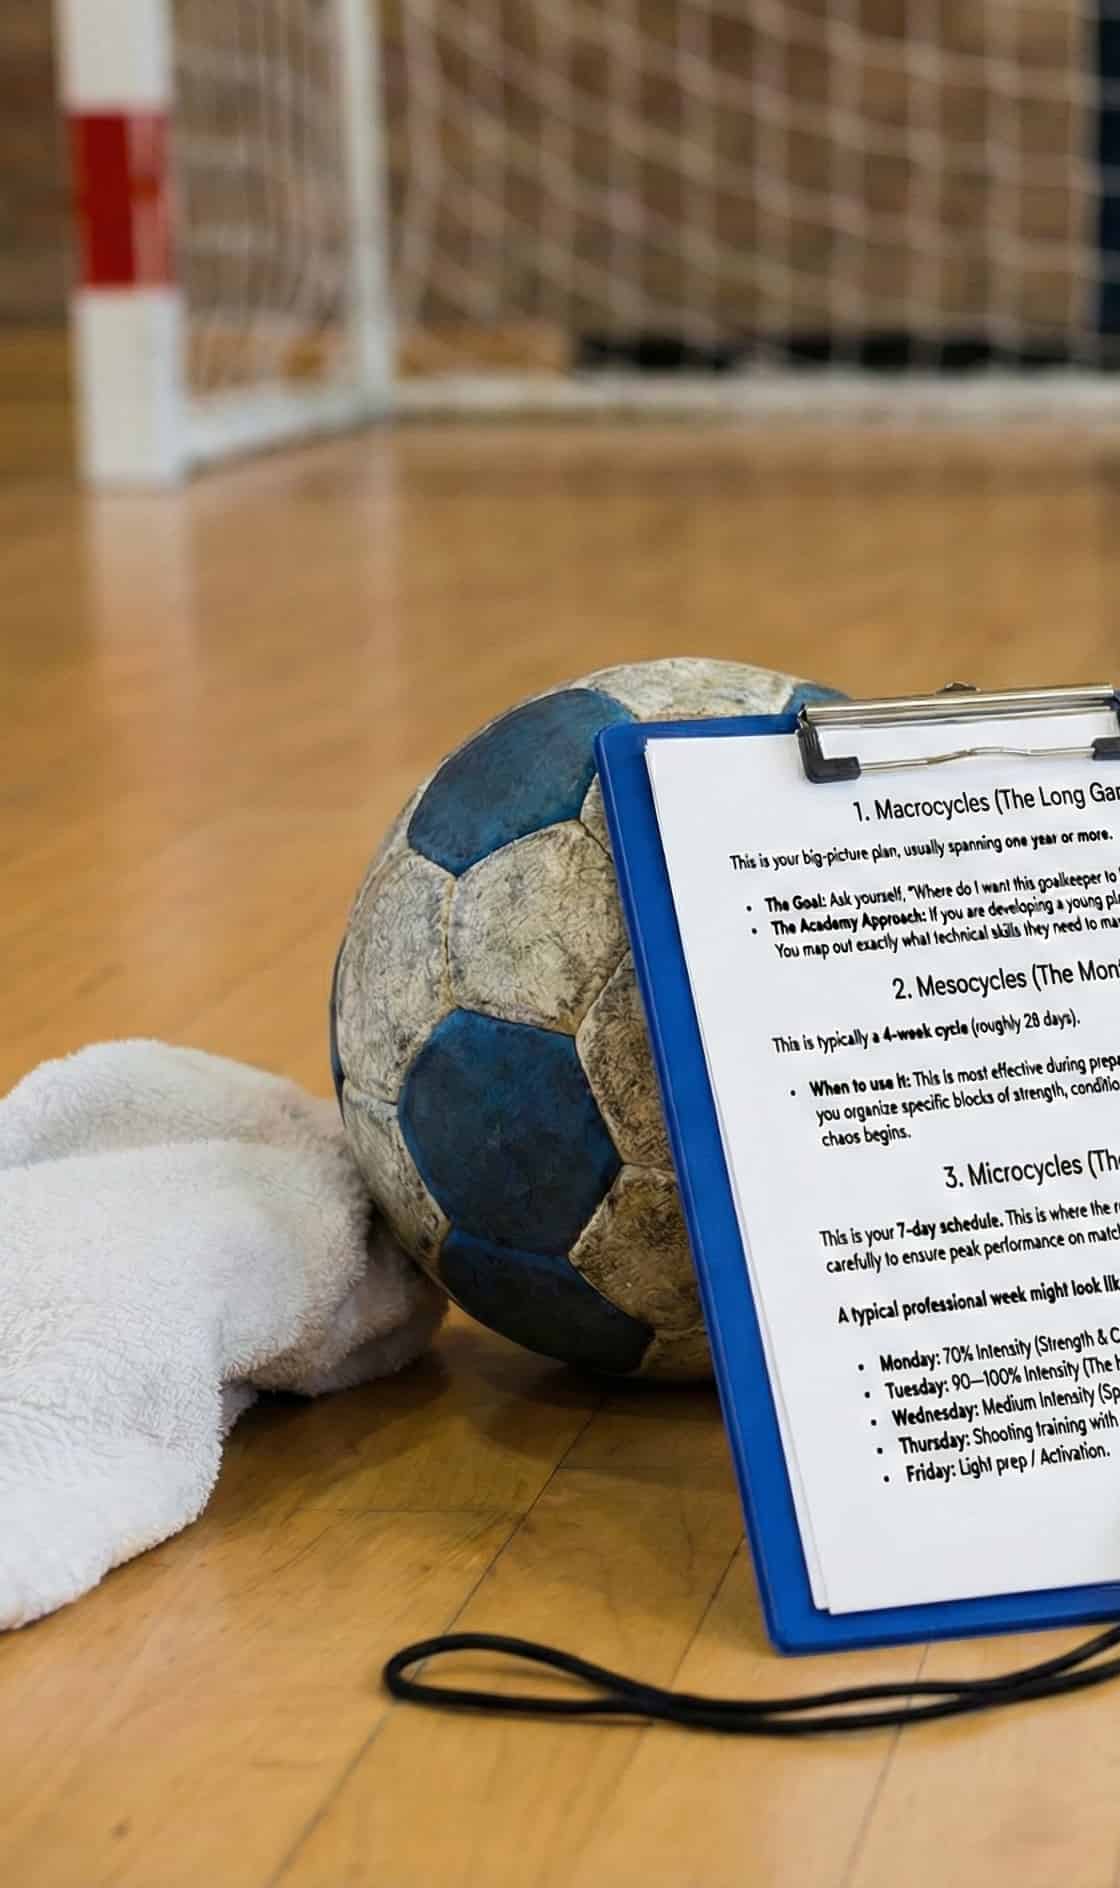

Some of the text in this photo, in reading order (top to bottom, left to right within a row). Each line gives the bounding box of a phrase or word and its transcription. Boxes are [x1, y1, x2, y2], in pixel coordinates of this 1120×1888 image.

[852, 801, 870, 822] 1.
[874, 791, 990, 820] Macrocycles
[994, 787, 1035, 815] (The
[1038, 785, 1086, 809] Long
[729, 829, 1113, 871] This is your big-picture plan, usually spanning one or more.
[763, 896, 790, 912] The
[792, 892, 827, 910] Goal:
[830, 890, 852, 907] Ask
[955, 880, 972, 896] do
[1012, 875, 1036, 891] this
[1103, 870, 1117, 883] to
[770, 919, 796, 936] The
[861, 907, 927, 931] Approach:
[928, 905, 937, 922] If
[940, 908, 963, 925] you
[1065, 895, 1103, 914] young
[774, 943, 800, 958] You
[802, 943, 830, 960] map
[832, 938, 853, 954] out
[901, 930, 931, 947] what
[933, 924, 989, 944] technical
[1023, 919, 1049, 939] they
[892, 977, 912, 999] 2.
[915, 967, 1027, 998] Mesocycles
[1031, 962, 1074, 992] (The
[771, 1007, 1080, 1054] This is typically (roughly 28 days).
[808, 1079, 850, 1096] When
[851, 1079, 867, 1093] to
[911, 1069, 941, 1087] This
[942, 1068, 954, 1084] is
[957, 1065, 988, 1083] most
[991, 1059, 1043, 1079] effective
[1046, 1055, 1087, 1075] during
[815, 1108, 840, 1127] you
[843, 1099, 898, 1122] organize
[901, 1093, 951, 1118] specific
[951, 1088, 994, 1108] blocks
[996, 1085, 1010, 1103] of
[821, 1123, 911, 1147] chaos begins.
[943, 1165, 964, 1188] 3.
[967, 1153, 1083, 1186] Microcycles
[818, 1228, 848, 1246] This
[849, 1227, 863, 1244] is
[864, 1227, 894, 1248] your
[895, 1219, 936, 1240] 7-day
[939, 1211, 1004, 1234] schedule.
[1004, 1207, 1033, 1225] This
[1034, 1206, 1047, 1223] is
[1048, 1203, 1088, 1221] where
[1089, 1199, 1111, 1216] the
[826, 1251, 882, 1274] carefully
[884, 1251, 899, 1266] to
[902, 1248, 946, 1264] ensure
[949, 1239, 982, 1264] peak
[983, 1234, 1065, 1260] performance
[1067, 1232, 1085, 1245] on
[838, 1306, 849, 1324] A
[850, 1299, 899, 1327] typical
[901, 1289, 987, 1321] professional
[989, 1285, 1027, 1305] week
[1029, 1281, 1069, 1304] might
[1070, 1276, 1103, 1296] look
[879, 1349, 941, 1372] Monday:
[942, 1344, 974, 1364] 70%
[975, 1338, 1031, 1360] Intensity
[1034, 1329, 1095, 1357] (Strength
[1097, 1328, 1109, 1345] &
[884, 1376, 949, 1399] Tuesday:
[1023, 1359, 1079, 1382] Intensity
[1082, 1356, 1113, 1378] (The
[891, 1401, 979, 1426] Wednesday:
[981, 1393, 1037, 1415] Medium
[1038, 1386, 1095, 1408] Intensity
[897, 1430, 970, 1454] Thursday:
[972, 1422, 1034, 1445] Shooting
[1035, 1415, 1087, 1437] training
[1088, 1409, 1119, 1429] with
[905, 1441, 1110, 1483] Friday: Light prep Activation.
